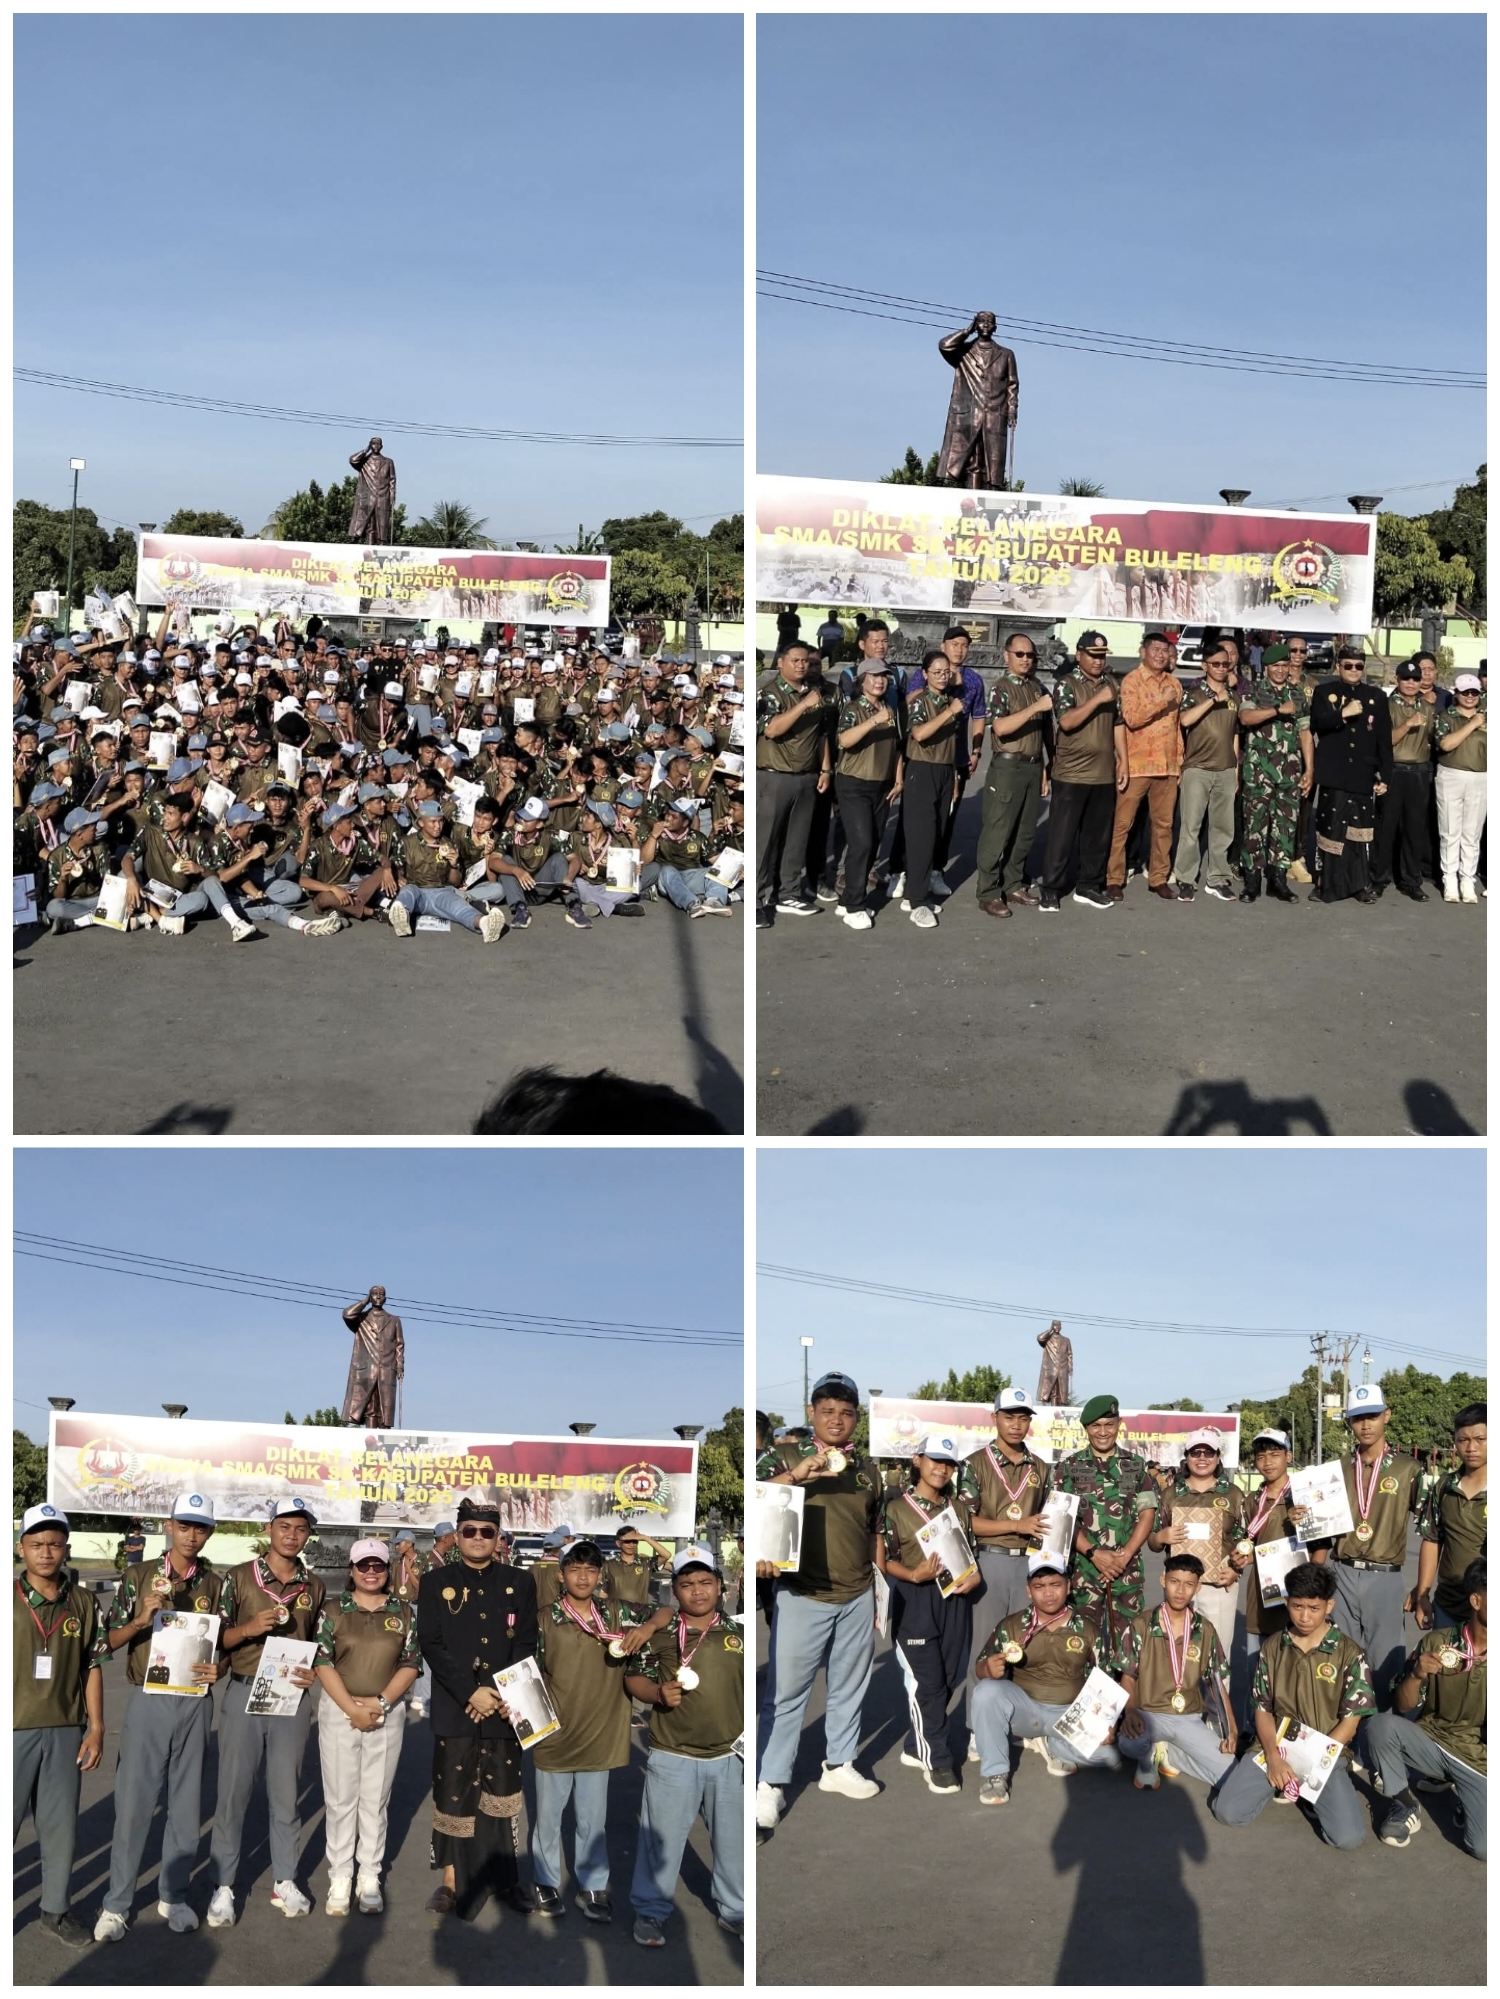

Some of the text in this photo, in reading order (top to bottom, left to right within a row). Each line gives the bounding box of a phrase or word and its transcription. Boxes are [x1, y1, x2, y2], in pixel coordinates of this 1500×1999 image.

[832, 508, 1123, 545] DIKLAT BELANEGARA
[774, 525, 903, 552] SMA/SMK
[912, 534, 1115, 565] SE-KABUPATEN
[1125, 548, 1262, 574] BULELENG
[259, 568, 331, 582] SMA/SMK
[459, 577, 542, 593] BULELENG
[906, 558, 1071, 586] TAHUN 2025
[265, 1446, 493, 1471] DIKLAT BELANEGARA
[222, 1460, 321, 1480] SMA/SMK
[328, 1466, 487, 1486] SE-KABUPATEN
[495, 1472, 606, 1491] BULELENG
[324, 1484, 453, 1503] TAHUN 2025
